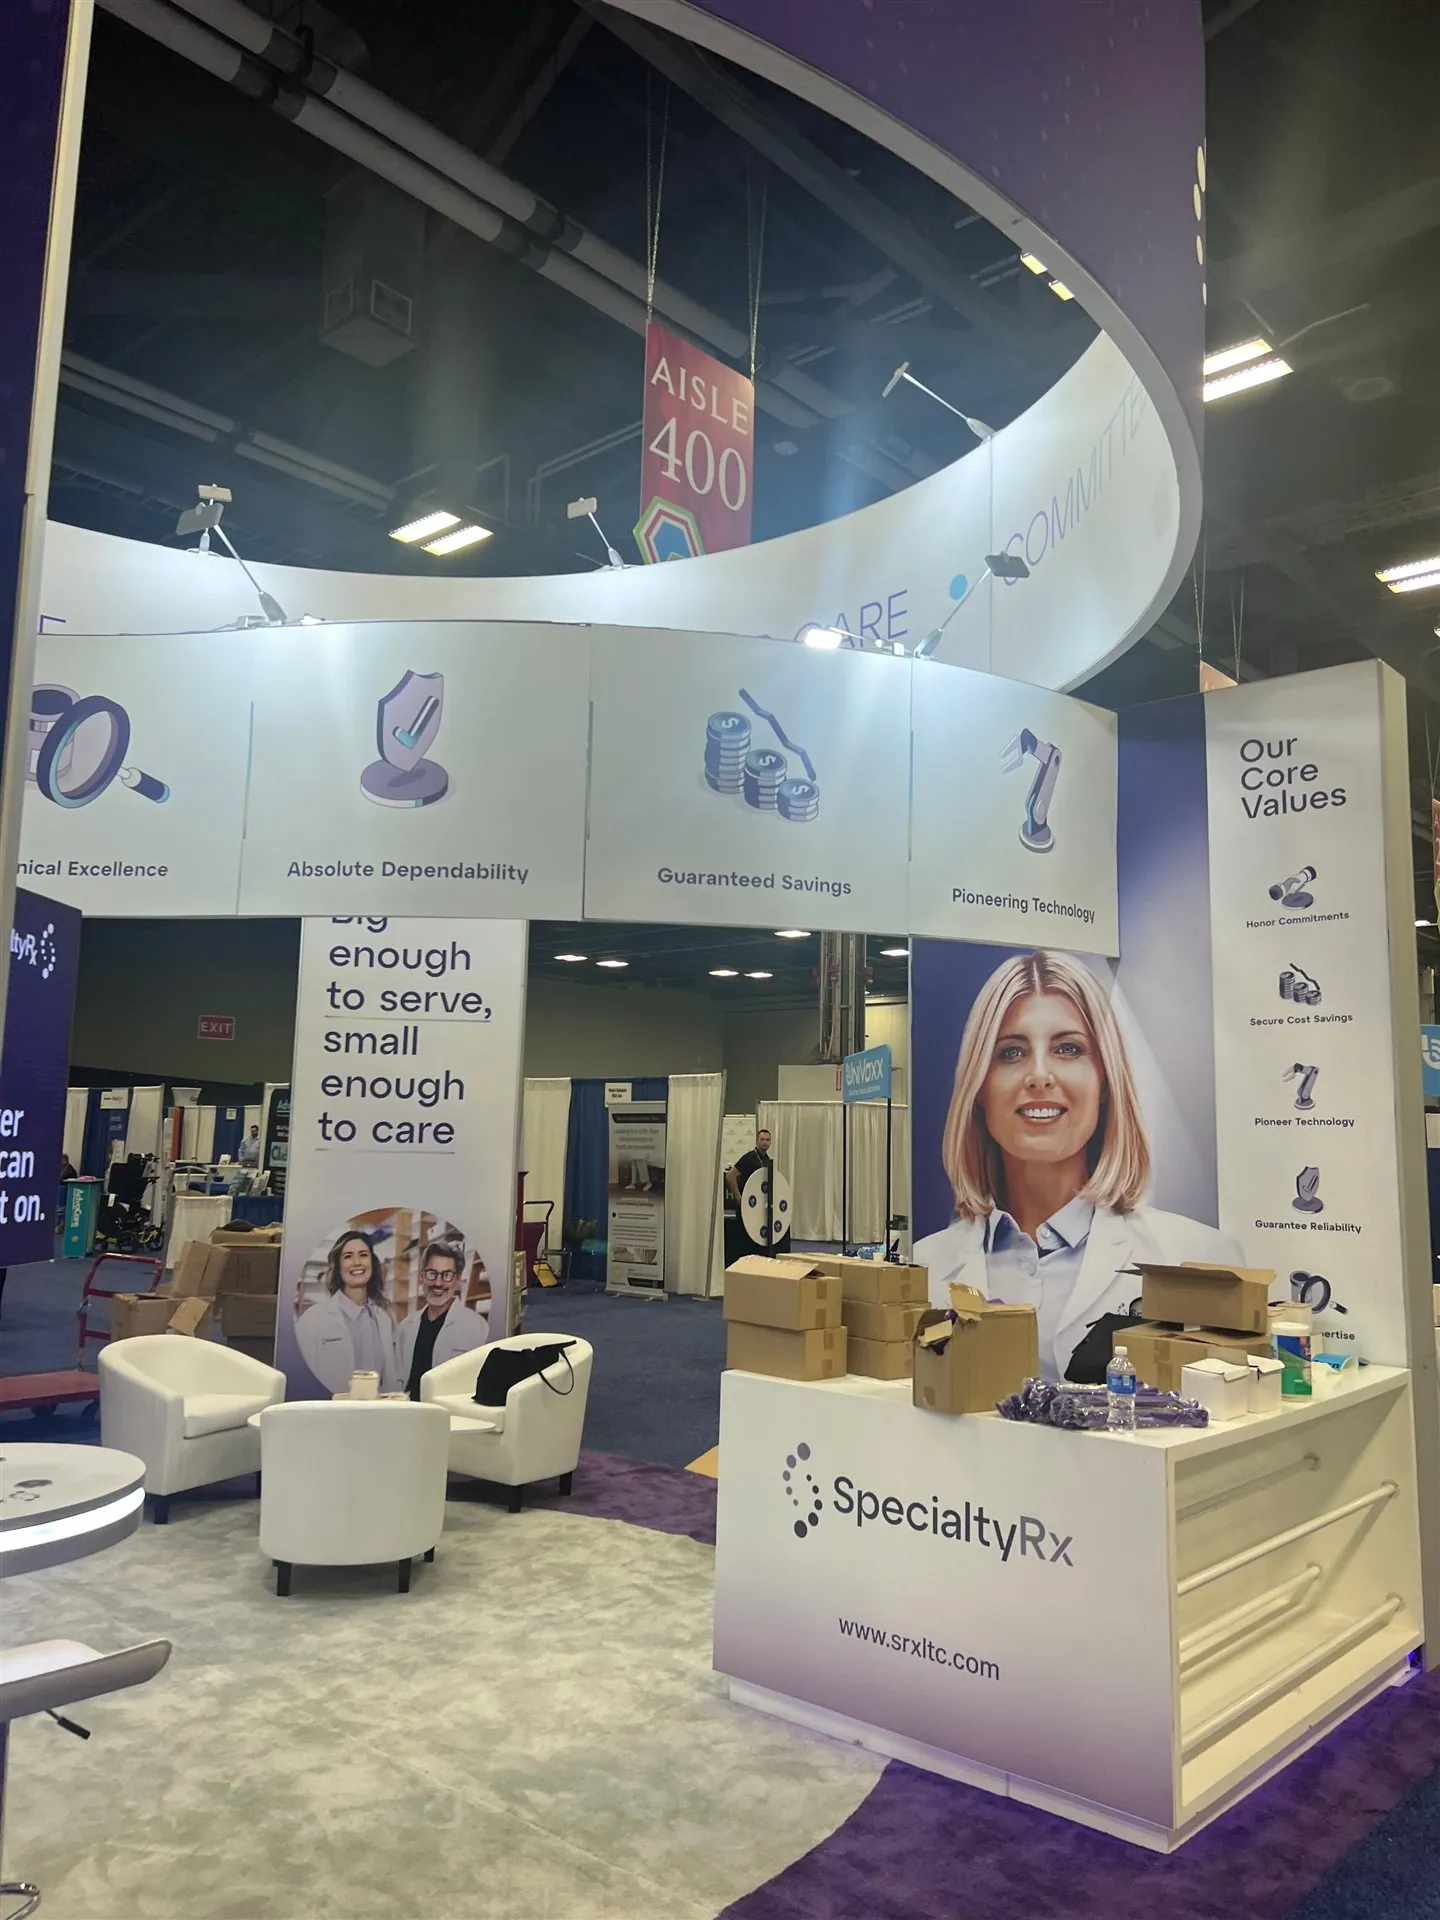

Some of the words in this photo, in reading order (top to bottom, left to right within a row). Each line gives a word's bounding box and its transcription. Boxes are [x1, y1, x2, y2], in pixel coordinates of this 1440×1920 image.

[651, 357, 749, 435] AISLE
[649, 417, 747, 511] 400
[1240, 737, 1298, 763] Our
[1241, 763, 1319, 791] Core
[1241, 787, 1347, 819] Values
[68, 861, 169, 877] Excellence
[287, 860, 374, 877] Absolute
[382, 861, 529, 885] Dependability
[657, 867, 775, 889] Guaranteed
[782, 874, 852, 897] Savings
[952, 887, 1029, 914] Pioneering
[1032, 897, 1096, 924] Technology
[1246, 919, 1277, 928] Honor
[1278, 911, 1350, 926] Commitments
[329, 941, 471, 978] enough
[326, 981, 365, 1011] to
[380, 990, 492, 1019] serve,
[201, 1021, 233, 1034] EXIT
[1249, 1017, 1284, 1026] Secure
[1286, 1014, 1311, 1025] Cost
[1313, 1013, 1354, 1024] Savings
[323, 1025, 419, 1056] small
[321, 1070, 465, 1108] enough
[0, 1109, 24, 1137] er
[318, 1112, 357, 1142] to
[372, 1121, 455, 1145] care
[1254, 1117, 1293, 1126] Pioneer
[1296, 1117, 1355, 1127] Technology
[14, 1194, 45, 1223] on.
[1255, 1219, 1307, 1229] Guarantee
[1310, 1222, 1362, 1235] Reliability
[1321, 1330, 1355, 1341] ertise
[833, 1475, 1074, 1568] SpecialtyRx
[839, 1617, 1000, 1681] www.srxltc.com
